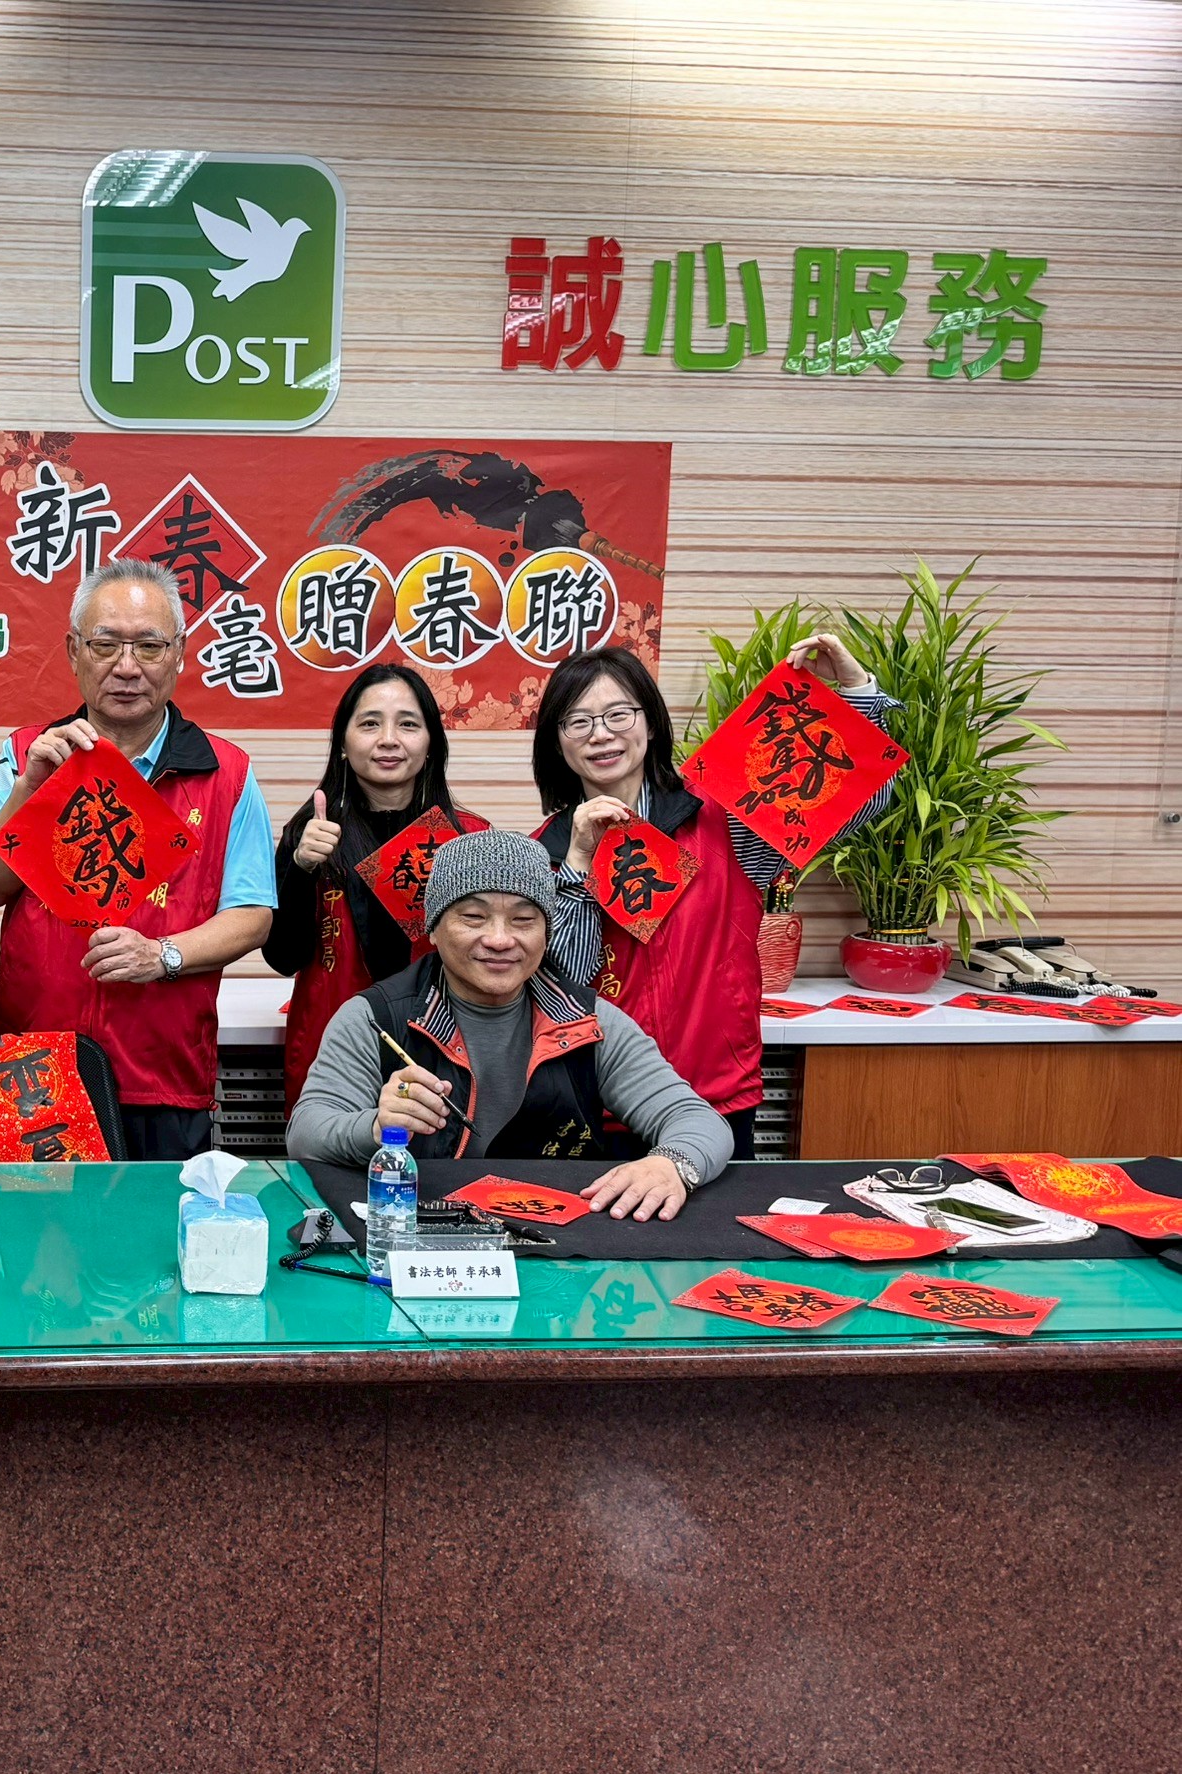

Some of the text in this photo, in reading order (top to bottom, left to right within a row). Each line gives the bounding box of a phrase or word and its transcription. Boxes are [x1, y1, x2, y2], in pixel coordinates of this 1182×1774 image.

[112, 275, 309, 386] POST
[501, 236, 1048, 380] 誠心服務
[605, 833, 678, 915] 春
[408, 1265, 458, 1279] 書法老師
